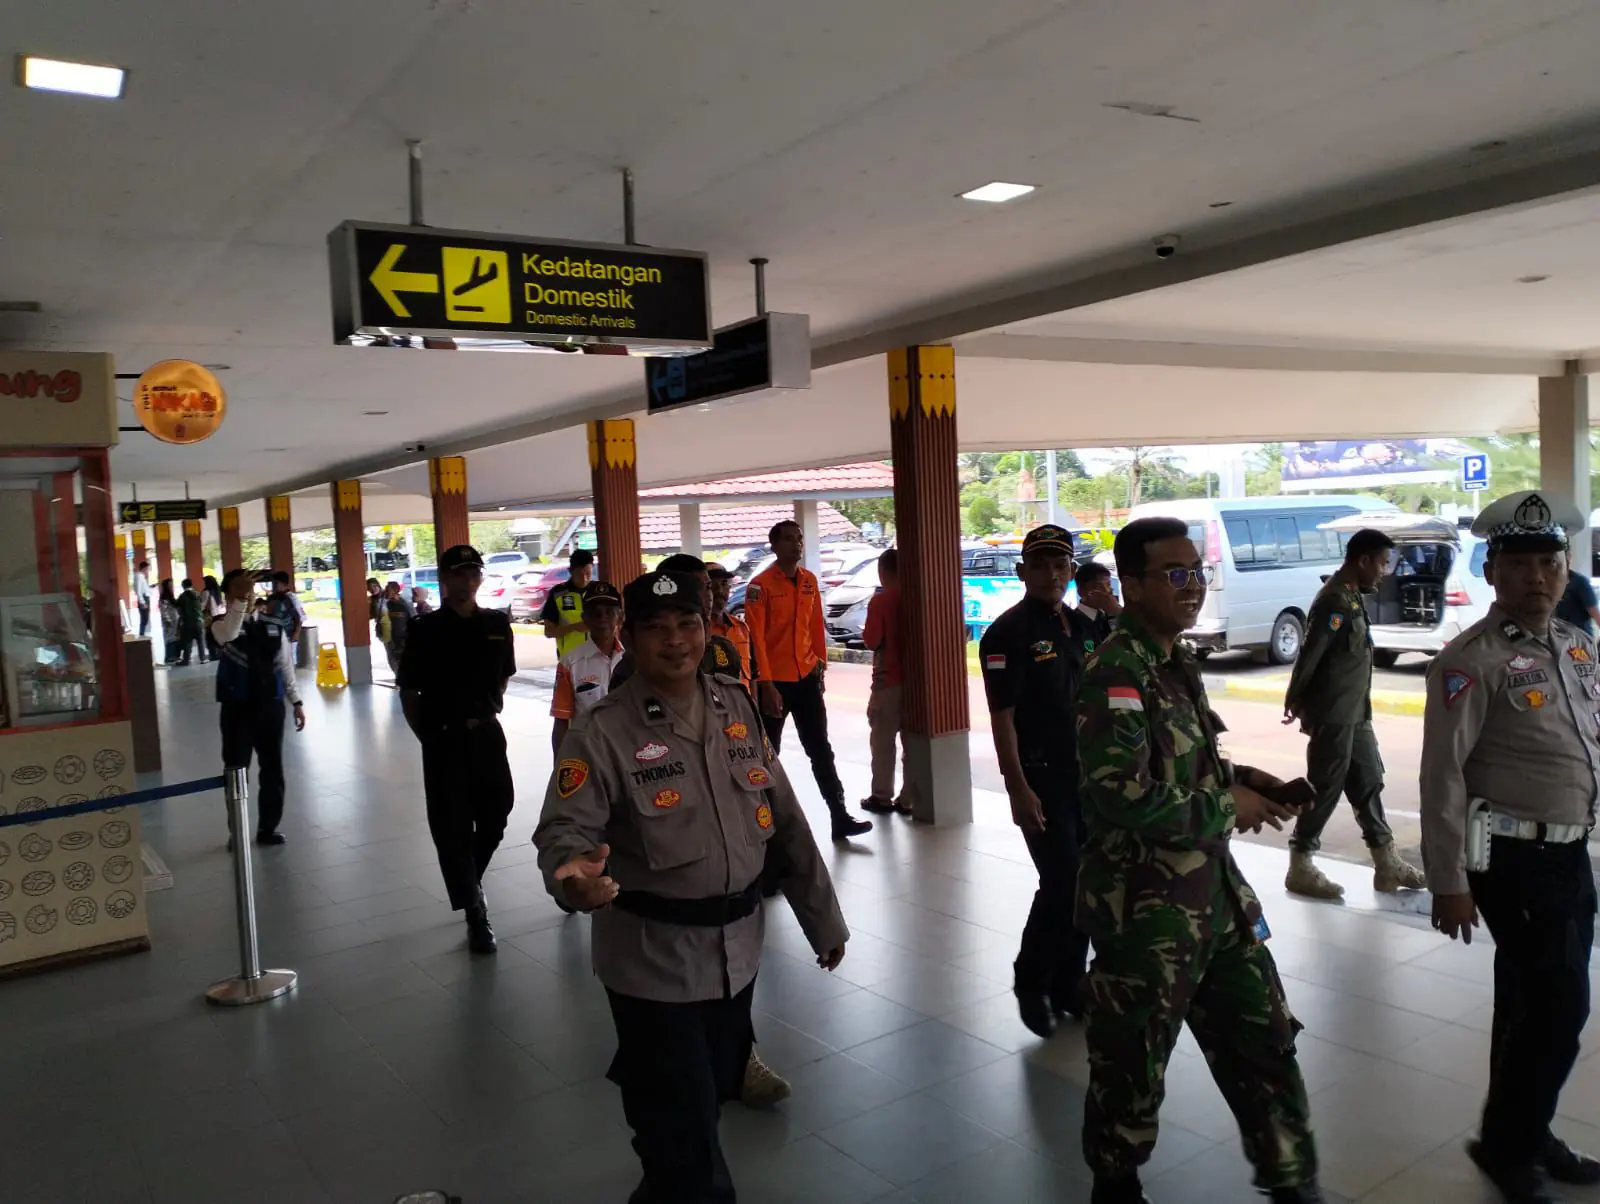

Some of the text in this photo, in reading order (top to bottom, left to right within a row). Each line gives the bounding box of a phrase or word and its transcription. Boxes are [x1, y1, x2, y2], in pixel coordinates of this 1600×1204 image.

[522, 253, 662, 286] Kedatangan
[524, 282, 635, 309] Domestik
[526, 310, 636, 329] Domestic Arrivals
[1467, 458, 1482, 479] P
[728, 746, 760, 762] POLRI
[630, 760, 686, 785] THOMAS
